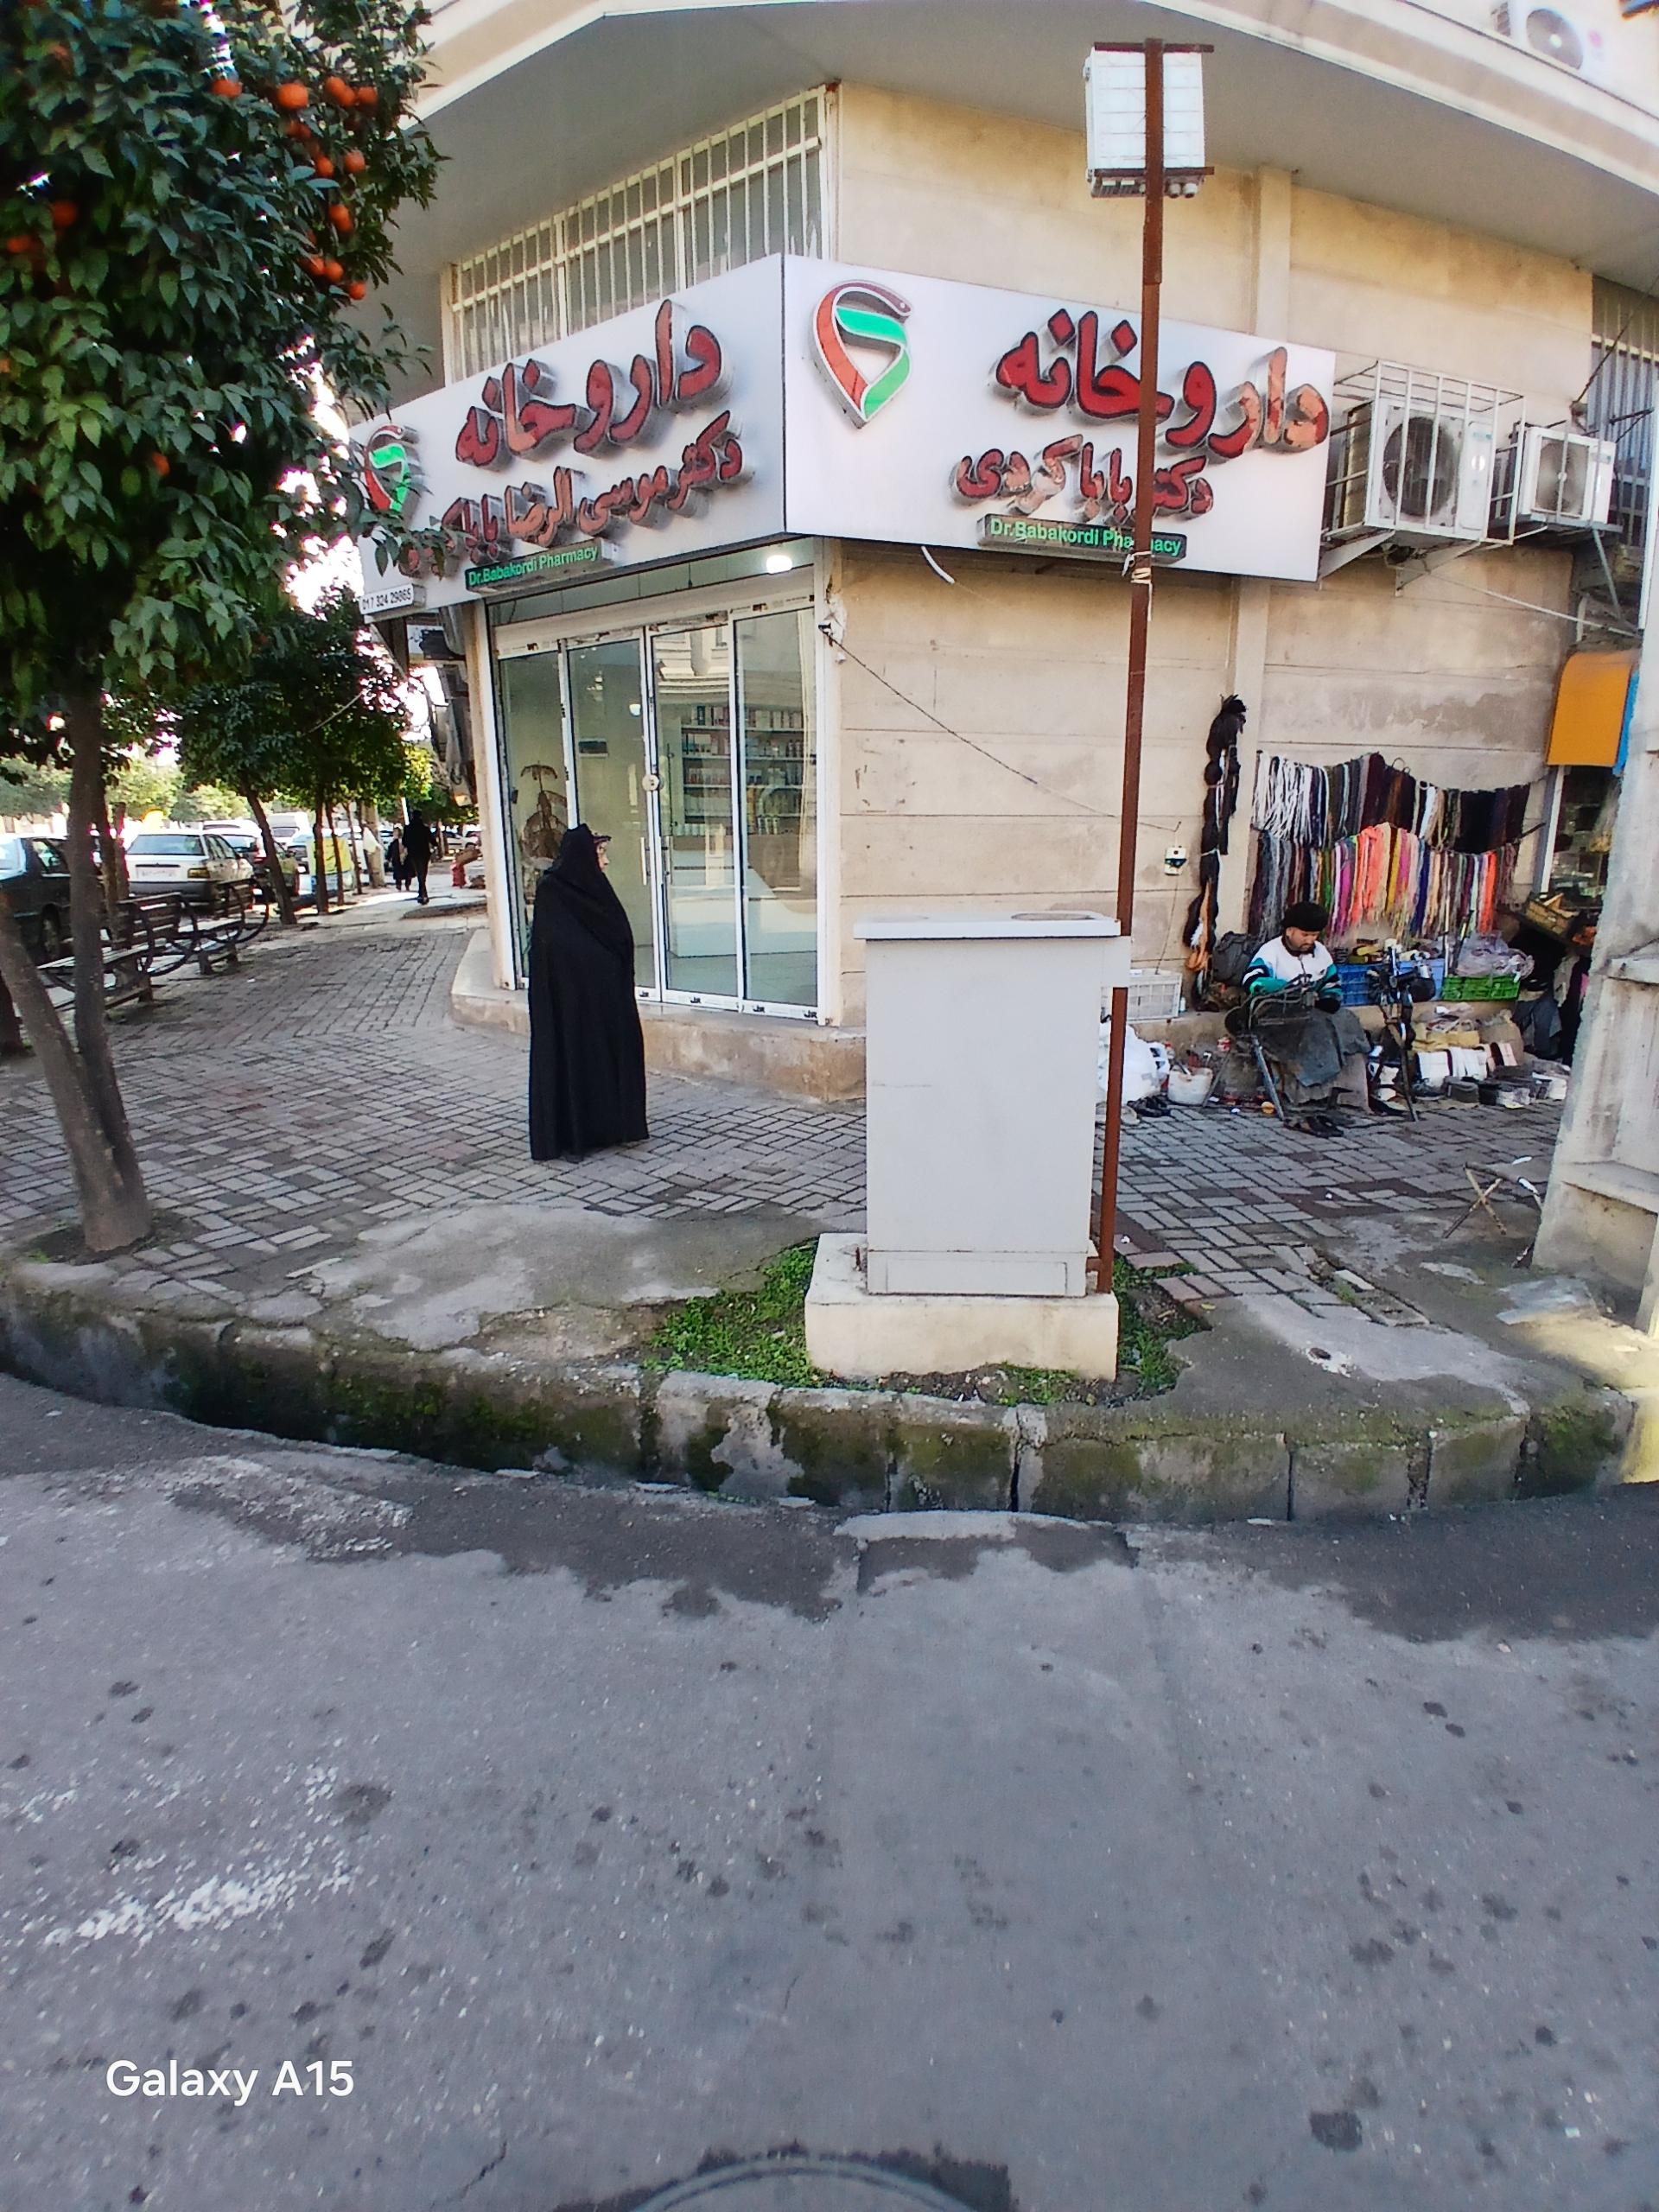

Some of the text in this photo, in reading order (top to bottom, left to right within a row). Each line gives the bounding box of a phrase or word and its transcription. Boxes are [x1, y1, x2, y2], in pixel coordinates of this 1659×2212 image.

[455, 299, 723, 467] داروخانه
[995, 308, 1330, 459] داروخانه
[667, 410, 743, 512] دکتر
[578, 465, 669, 537] موسی
[467, 544, 599, 587] Dr.Babakordi Pharmacy
[1103, 528, 1182, 556] Phaacy
[362, 596, 374, 610] 017
[376, 594, 389, 607] 324
